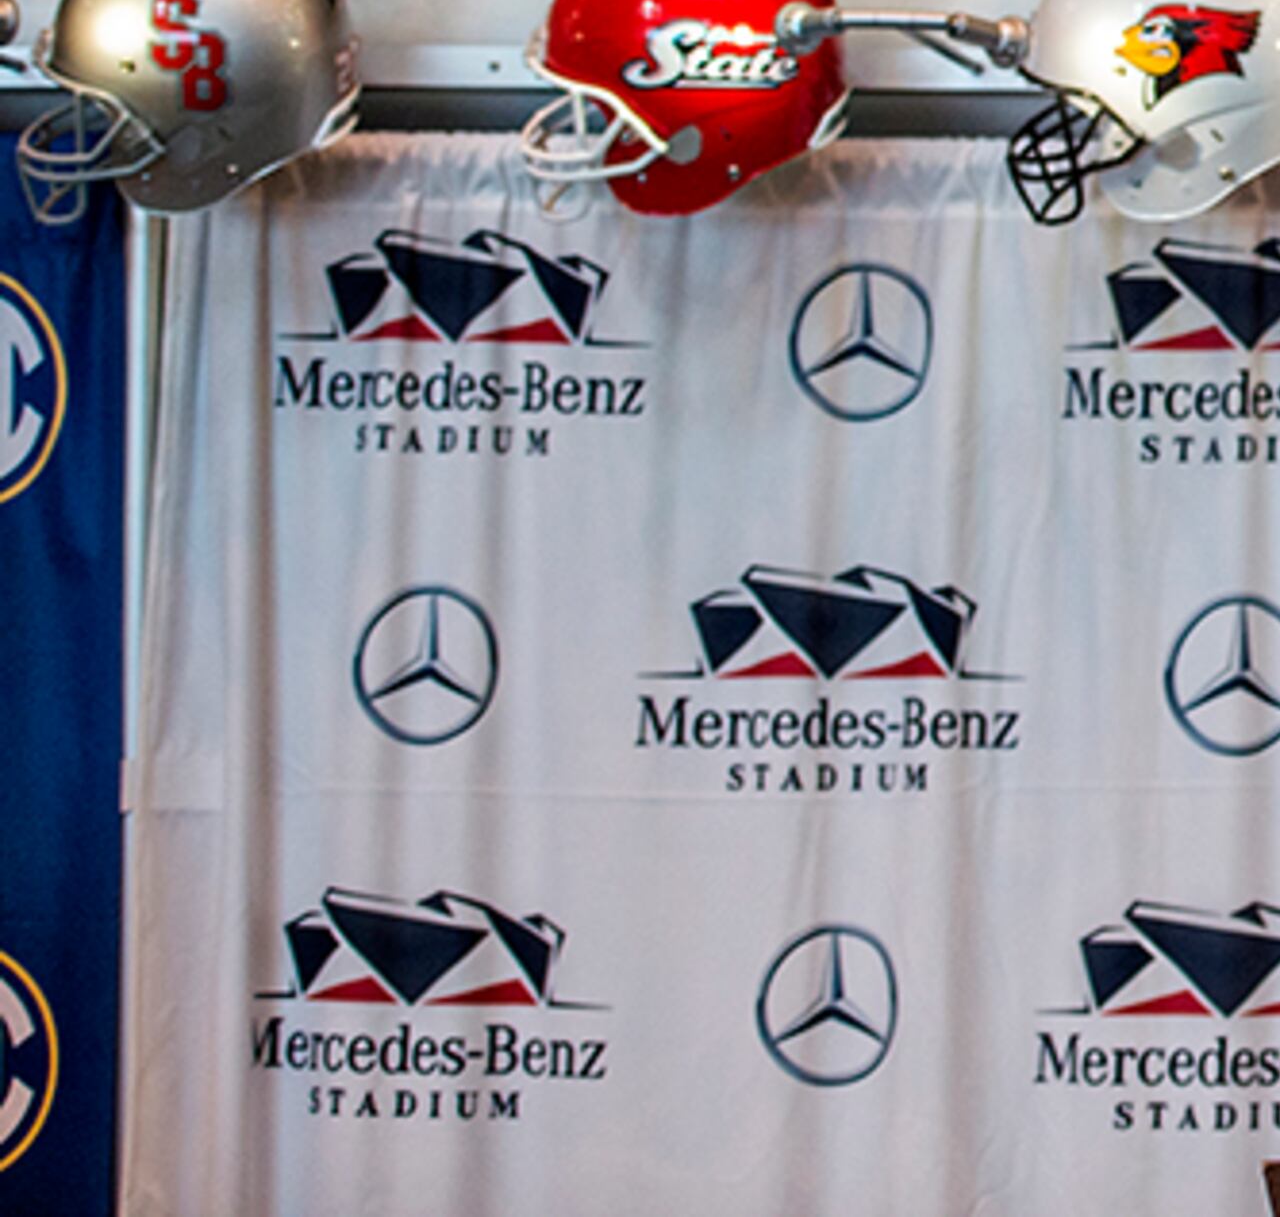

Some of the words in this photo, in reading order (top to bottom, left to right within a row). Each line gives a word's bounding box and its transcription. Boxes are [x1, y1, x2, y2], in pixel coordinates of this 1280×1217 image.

[622, 19, 800, 90] State
[272, 354, 646, 416] Mercedes-Benz
[355, 423, 550, 456] STADIUM
[635, 694, 1020, 750] Mercedes-Benz
[727, 762, 928, 793] STADIUM
[248, 1014, 607, 1080] Mercedes-Benz
[309, 1085, 520, 1122] STADIUM
